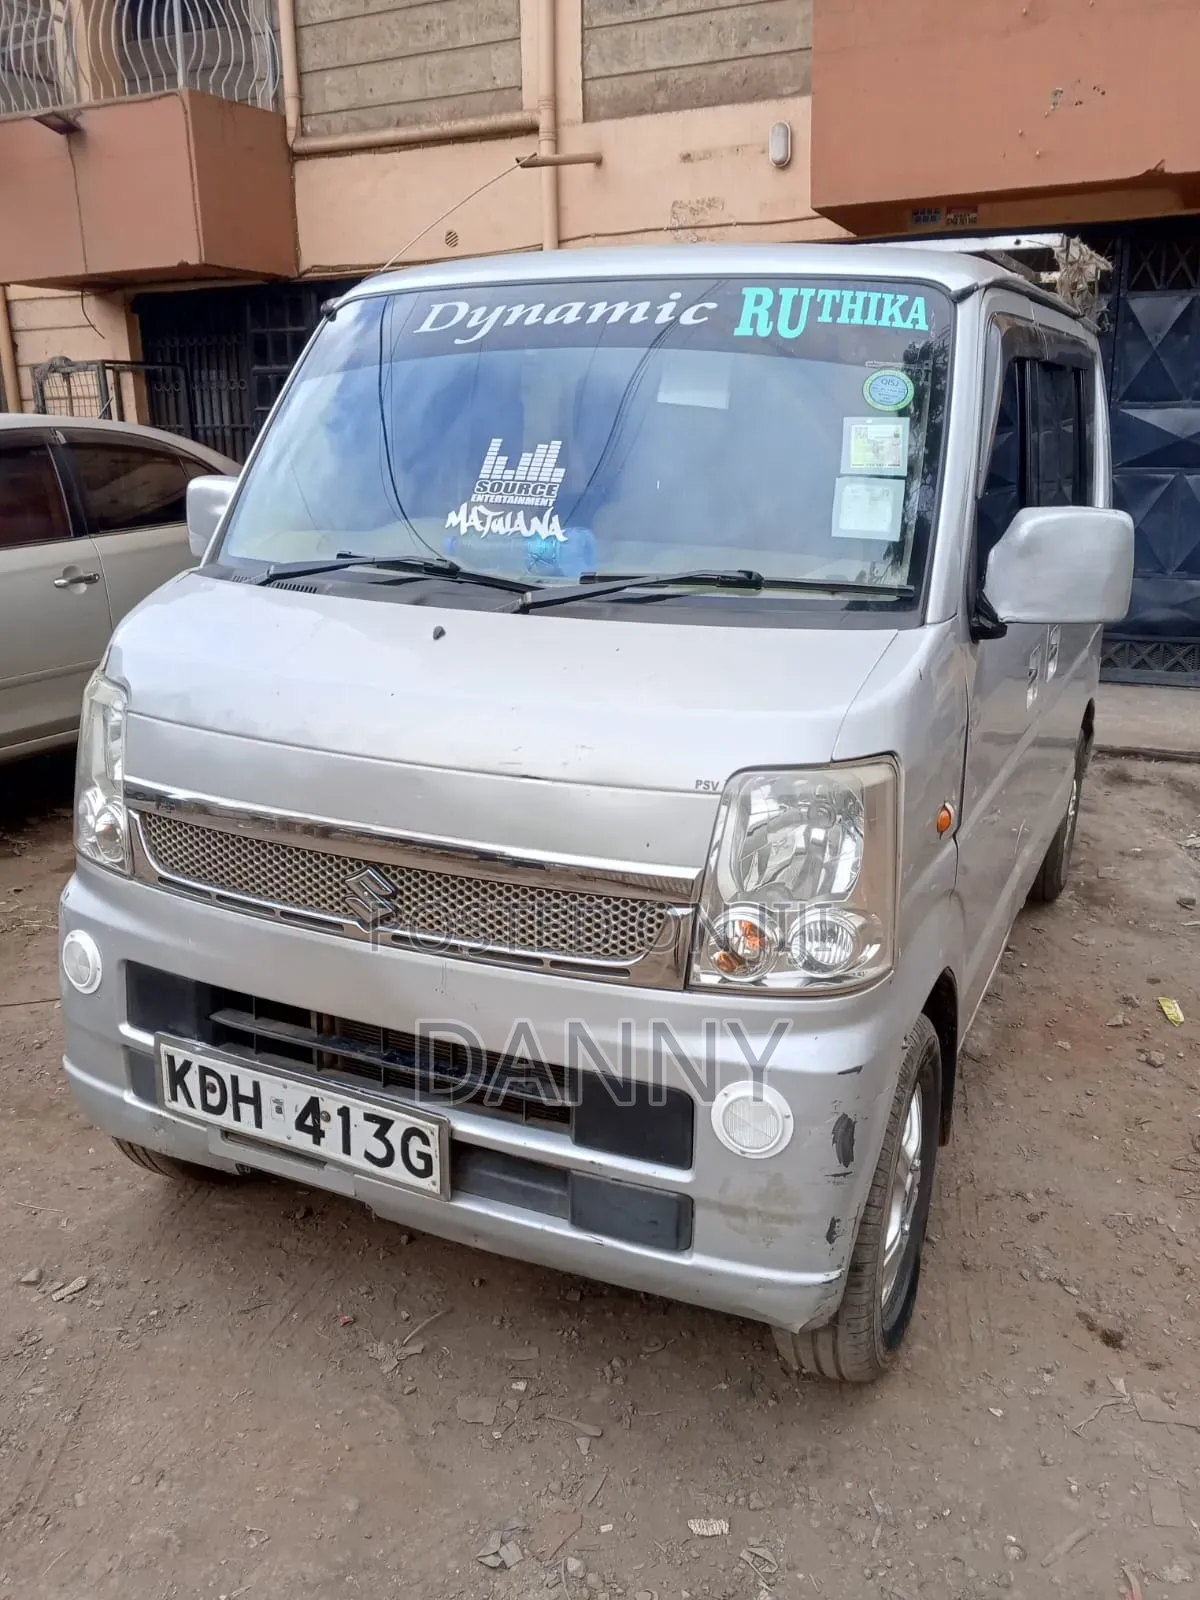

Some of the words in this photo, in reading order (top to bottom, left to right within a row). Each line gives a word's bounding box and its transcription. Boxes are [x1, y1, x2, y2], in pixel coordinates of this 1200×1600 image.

[413, 292, 718, 345] Dynamic
[474, 480, 560, 498] SOURCE
[471, 493, 557, 507] ENTERTAINMENT
[695, 779, 720, 791] PSV
[166, 1055, 263, 1130] KDH
[295, 1096, 434, 1179] 413G
